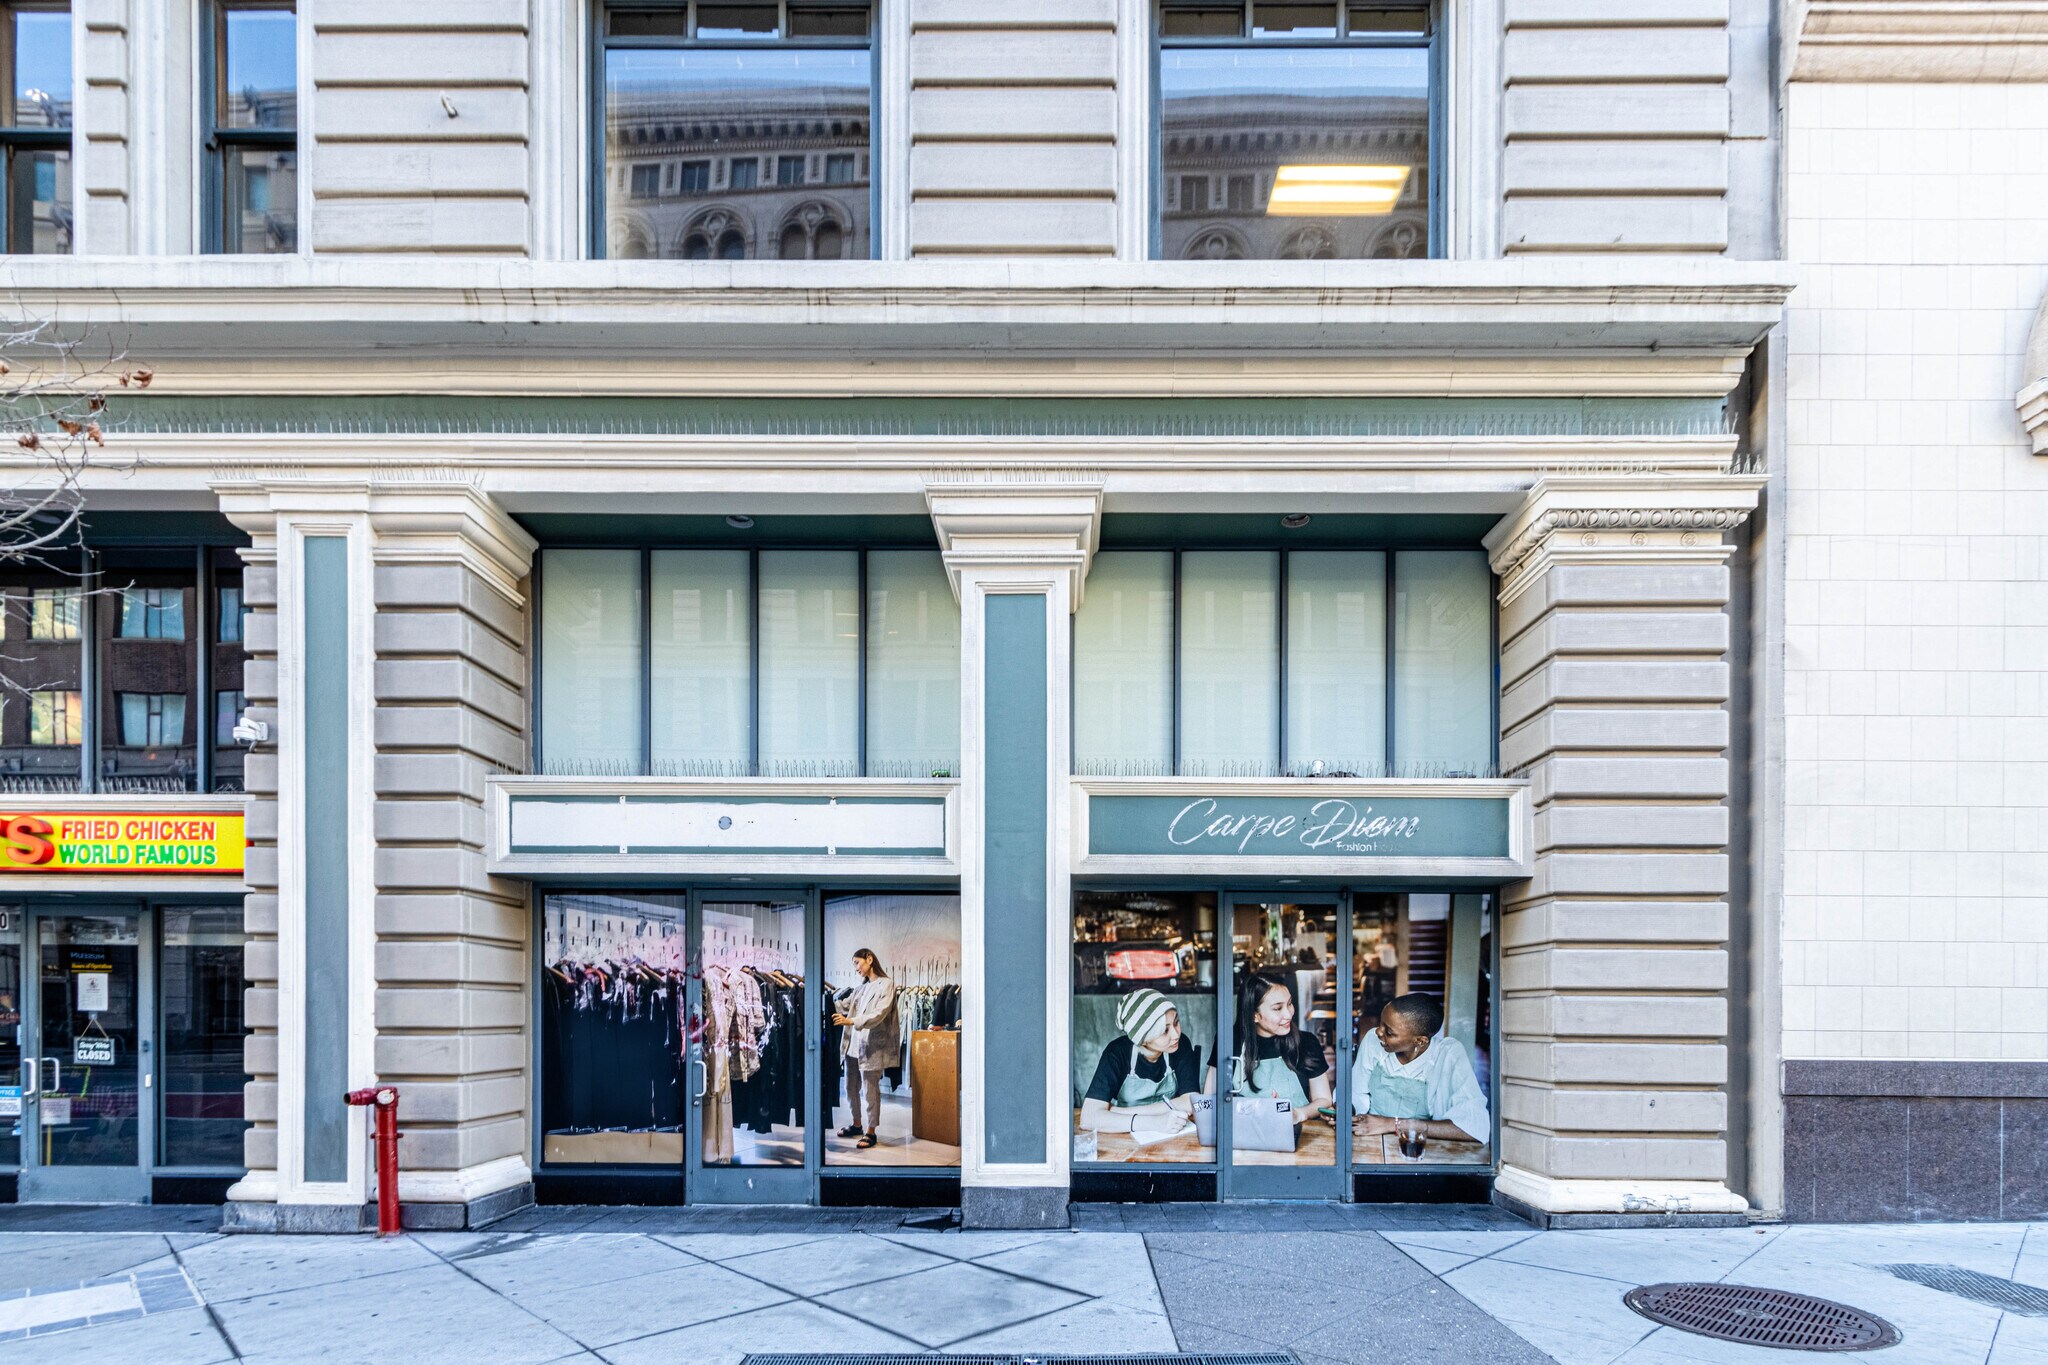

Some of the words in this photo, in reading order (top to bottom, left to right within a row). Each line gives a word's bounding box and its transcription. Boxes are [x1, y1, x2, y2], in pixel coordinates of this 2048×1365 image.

[62, 820, 121, 840] FRIED
[125, 820, 216, 841] CHICKEN
[1167, 797, 1296, 854] Carpe
[58, 844, 132, 865] WORLD
[135, 844, 218, 865] FAMOUS
[78, 1050, 111, 1060] CLOSED
